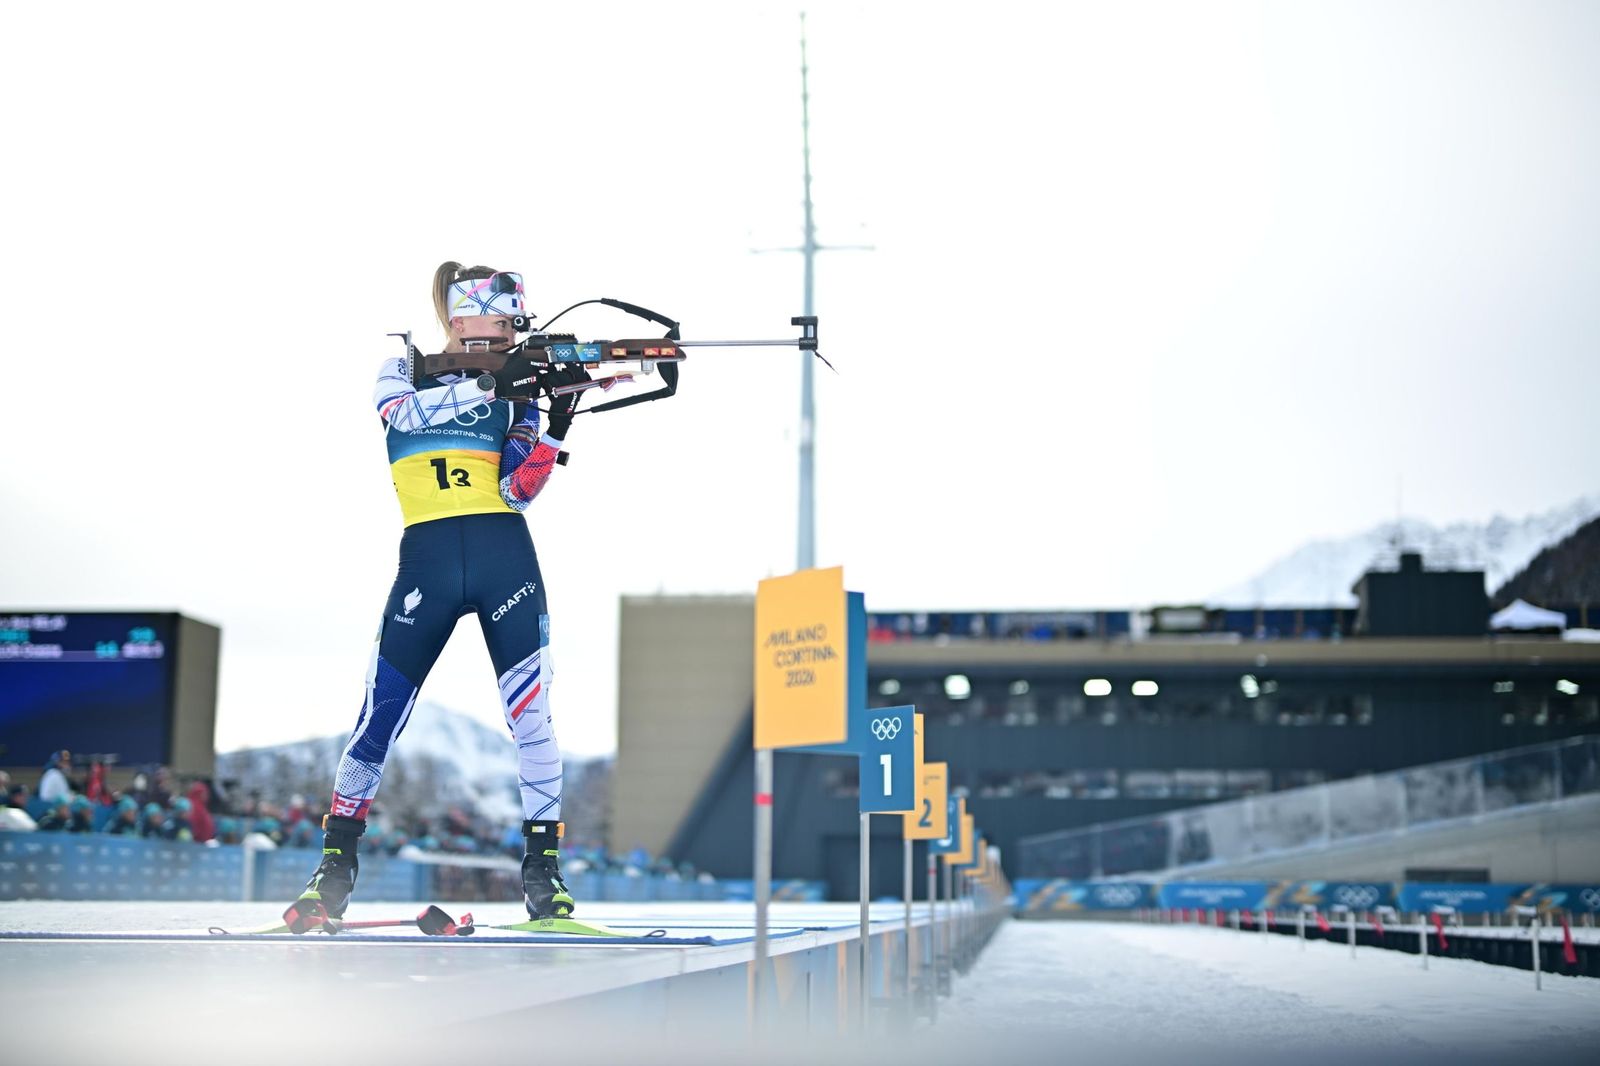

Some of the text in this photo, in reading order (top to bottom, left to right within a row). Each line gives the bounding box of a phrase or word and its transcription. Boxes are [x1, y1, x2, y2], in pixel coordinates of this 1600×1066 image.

[409, 428, 494, 442] MILANO CORTINA 2026
[491, 586, 529, 622] CRAFT
[393, 613, 416, 626] FRANCE
[763, 622, 828, 648] MILANO
[773, 643, 838, 669] CORTINA
[880, 754, 892, 796] 1
[918, 798, 932, 828] 2
